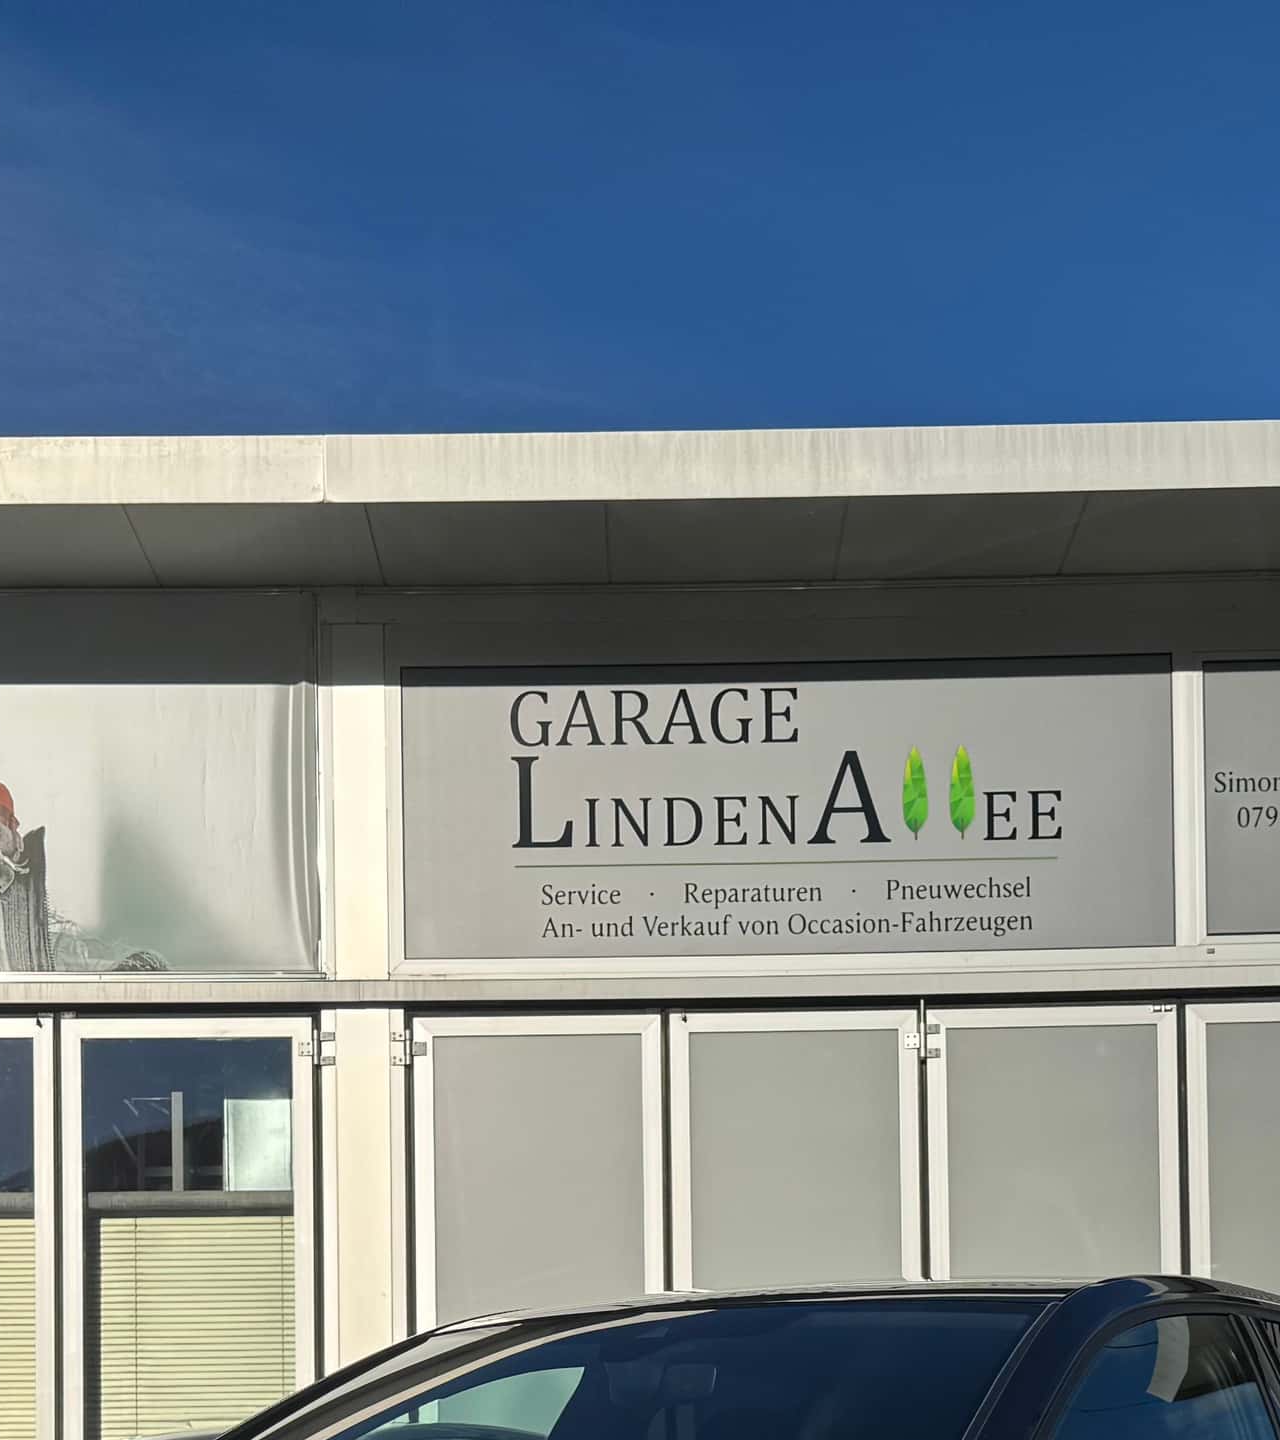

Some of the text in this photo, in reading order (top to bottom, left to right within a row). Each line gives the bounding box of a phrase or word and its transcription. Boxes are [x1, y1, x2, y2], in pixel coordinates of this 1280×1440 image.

[509, 687, 800, 747] GARAGE
[1237, 806, 1279, 829] 079
[541, 875, 1032, 910] Service Reparaturen Pneuwechsel
[541, 909, 1034, 939] An- und Verkauf von Occasion-Fahrzeugen
